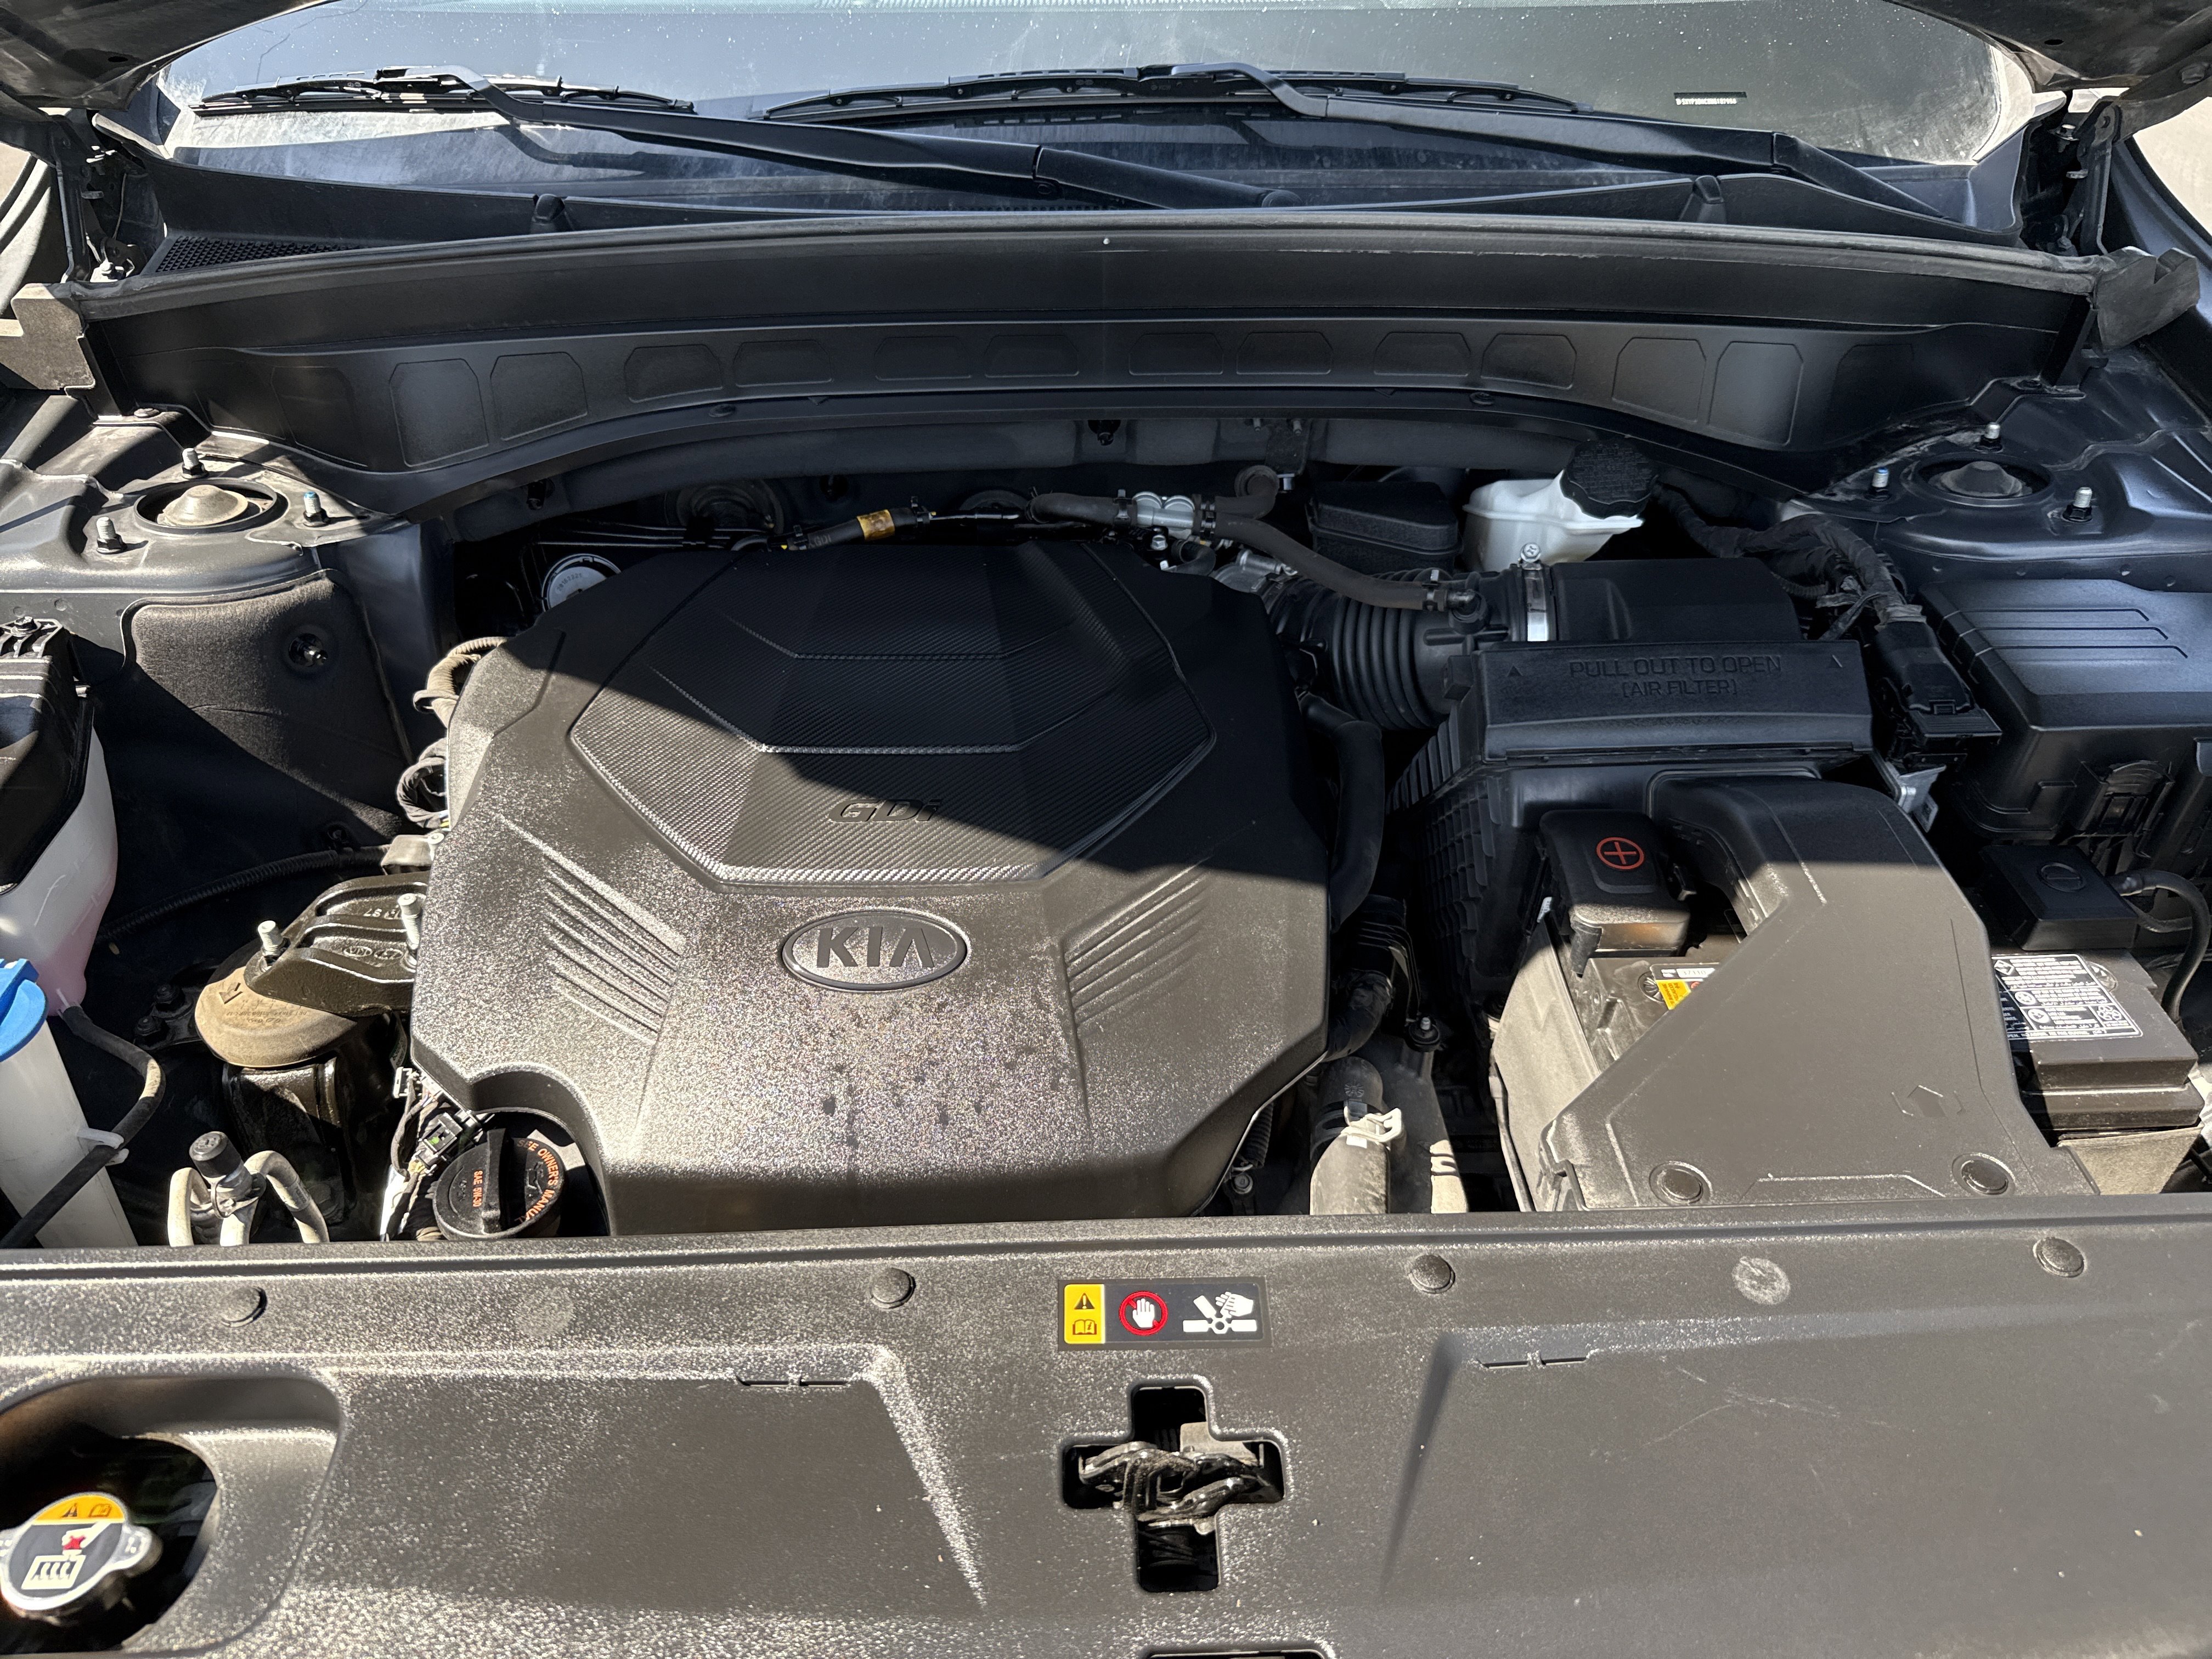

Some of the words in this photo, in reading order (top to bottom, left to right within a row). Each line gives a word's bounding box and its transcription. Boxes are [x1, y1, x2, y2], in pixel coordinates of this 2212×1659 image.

[1570, 659, 1628, 677] PULL
[1634, 657, 1679, 675] OUT
[1685, 656, 1716, 674] TO
[1723, 655, 1781, 673] OPEN
[816, 927, 935, 968] KIA
[517, 1139, 539, 1152] SEE
[473, 1171, 483, 1185] SAE
[538, 1148, 559, 1186] OWNER'S
[514, 1189, 555, 1223] MANUAL
